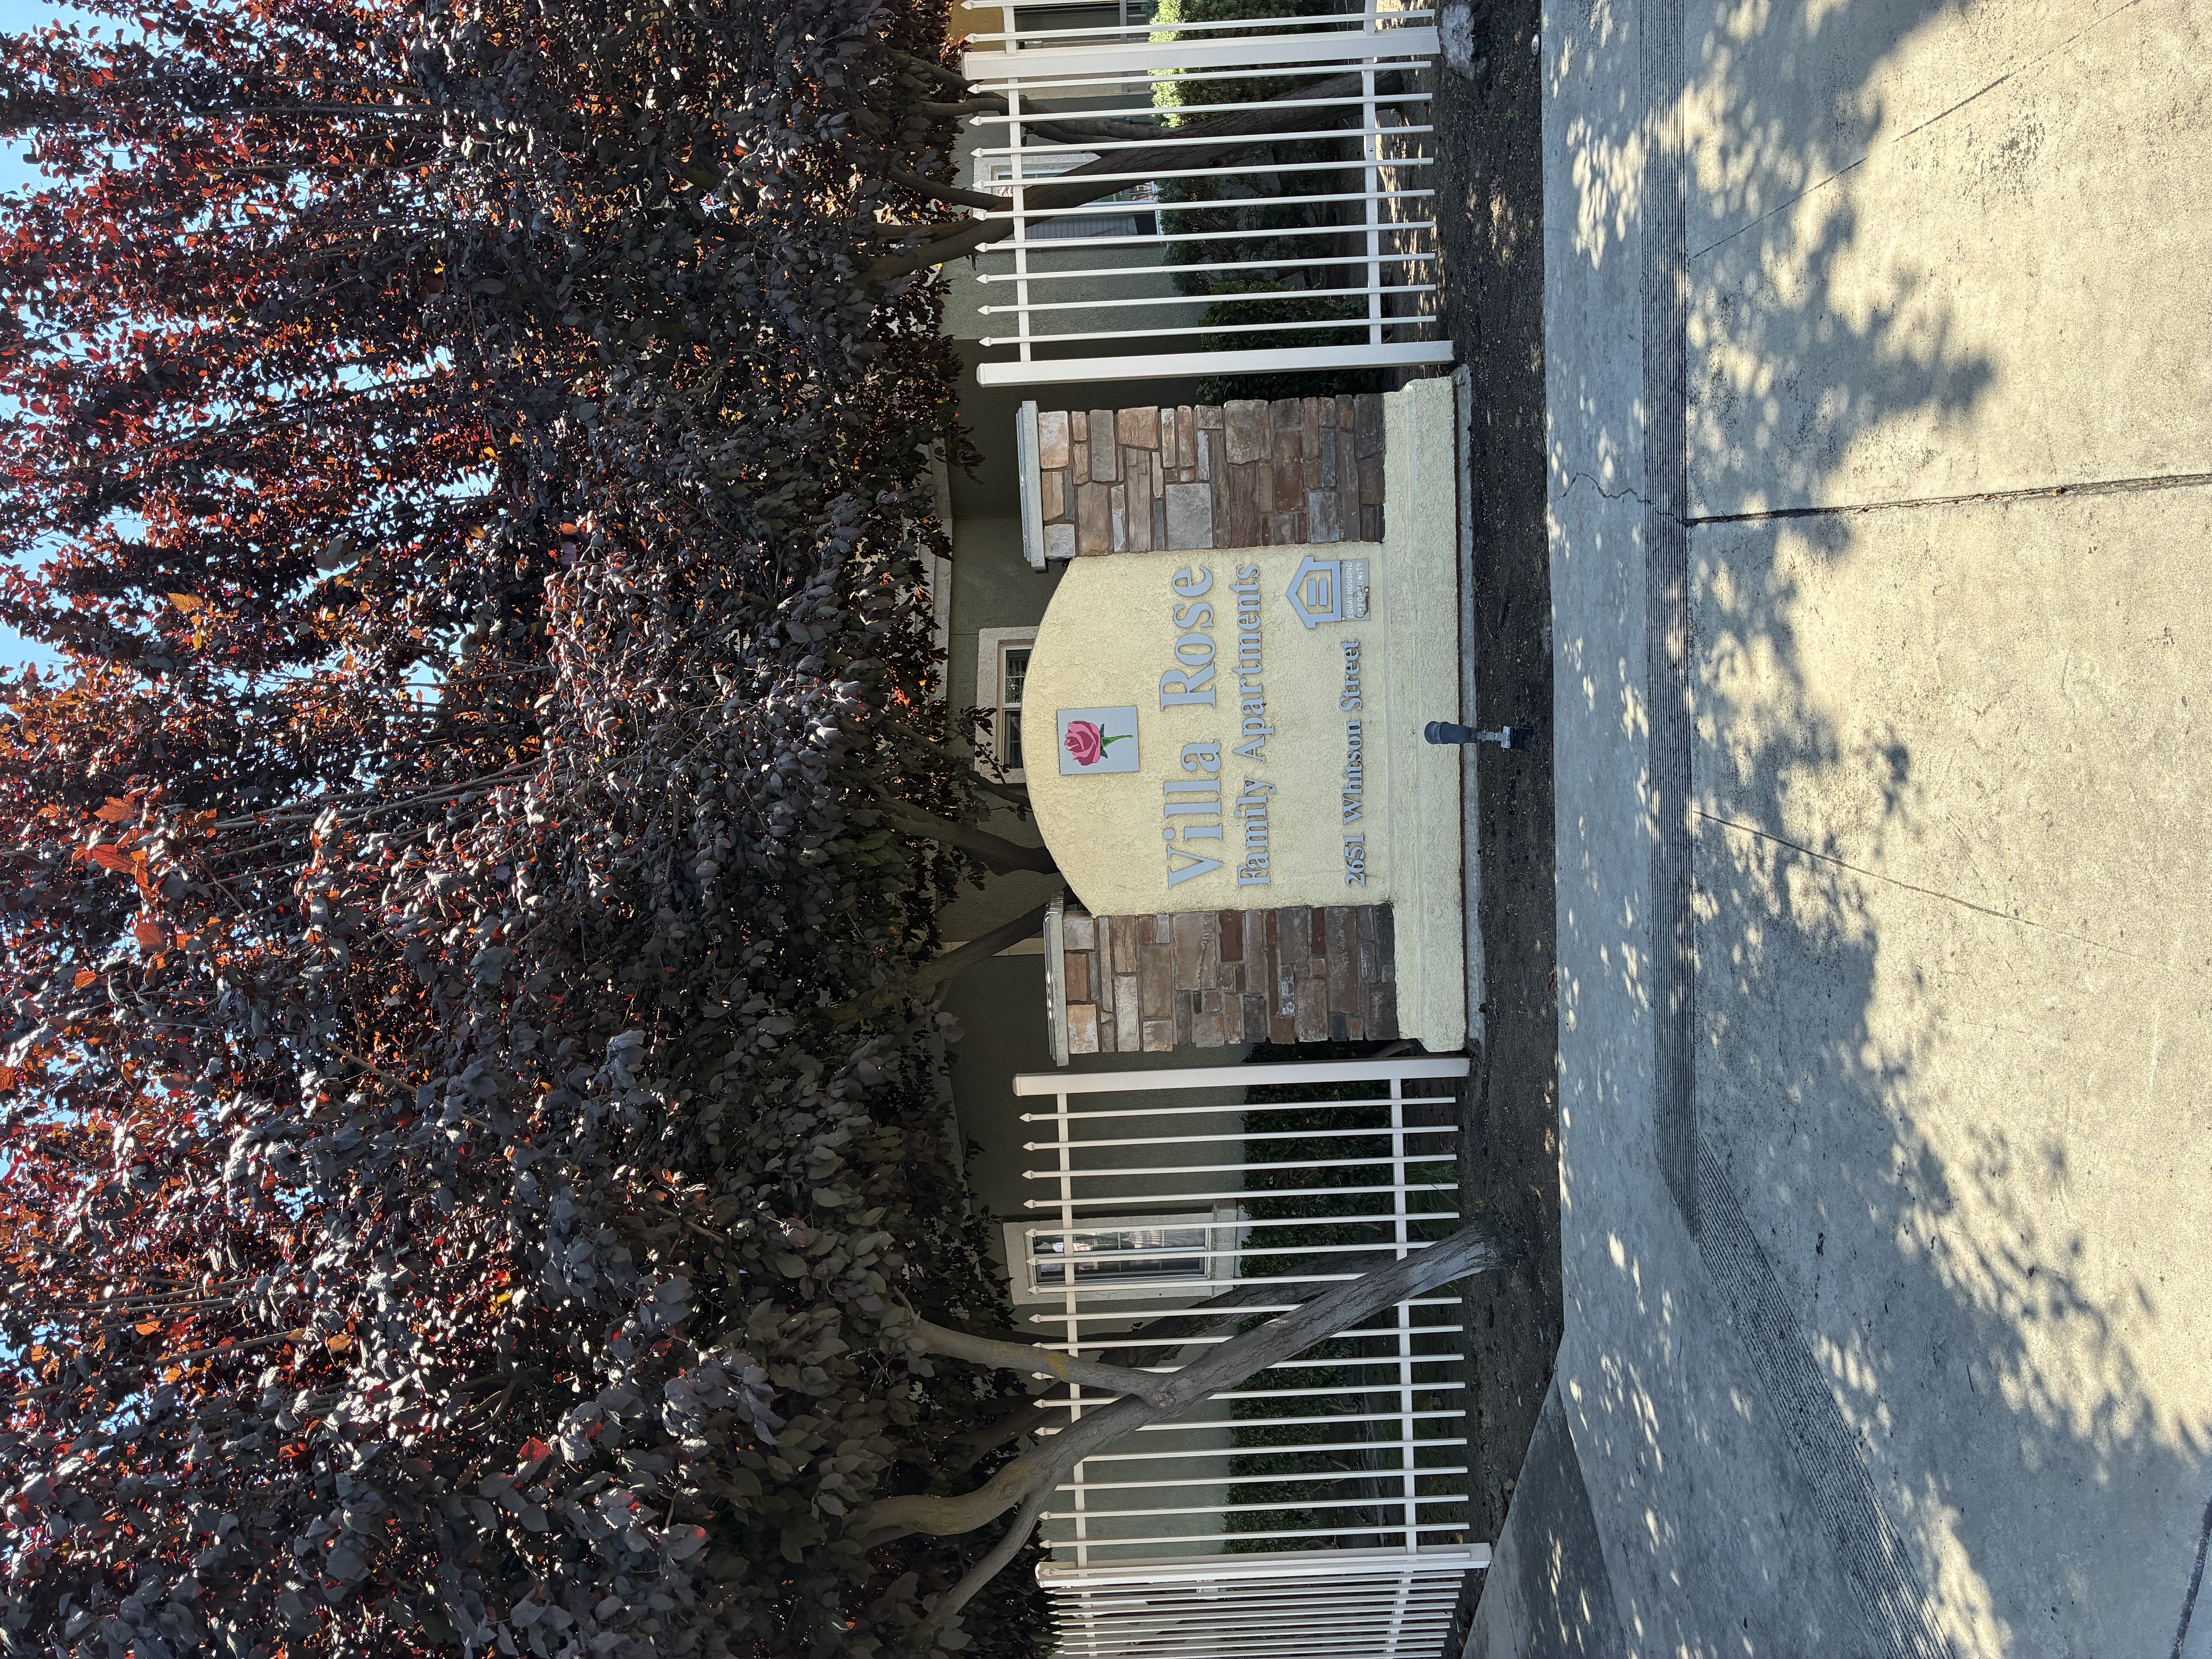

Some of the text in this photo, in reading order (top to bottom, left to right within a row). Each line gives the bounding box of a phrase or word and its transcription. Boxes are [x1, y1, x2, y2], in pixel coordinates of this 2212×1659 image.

[1159, 566, 1223, 888] Villa Rose
[1230, 565, 1276, 886] Family Apartments
[1339, 639, 1365, 886] 2651 Whitson Street
